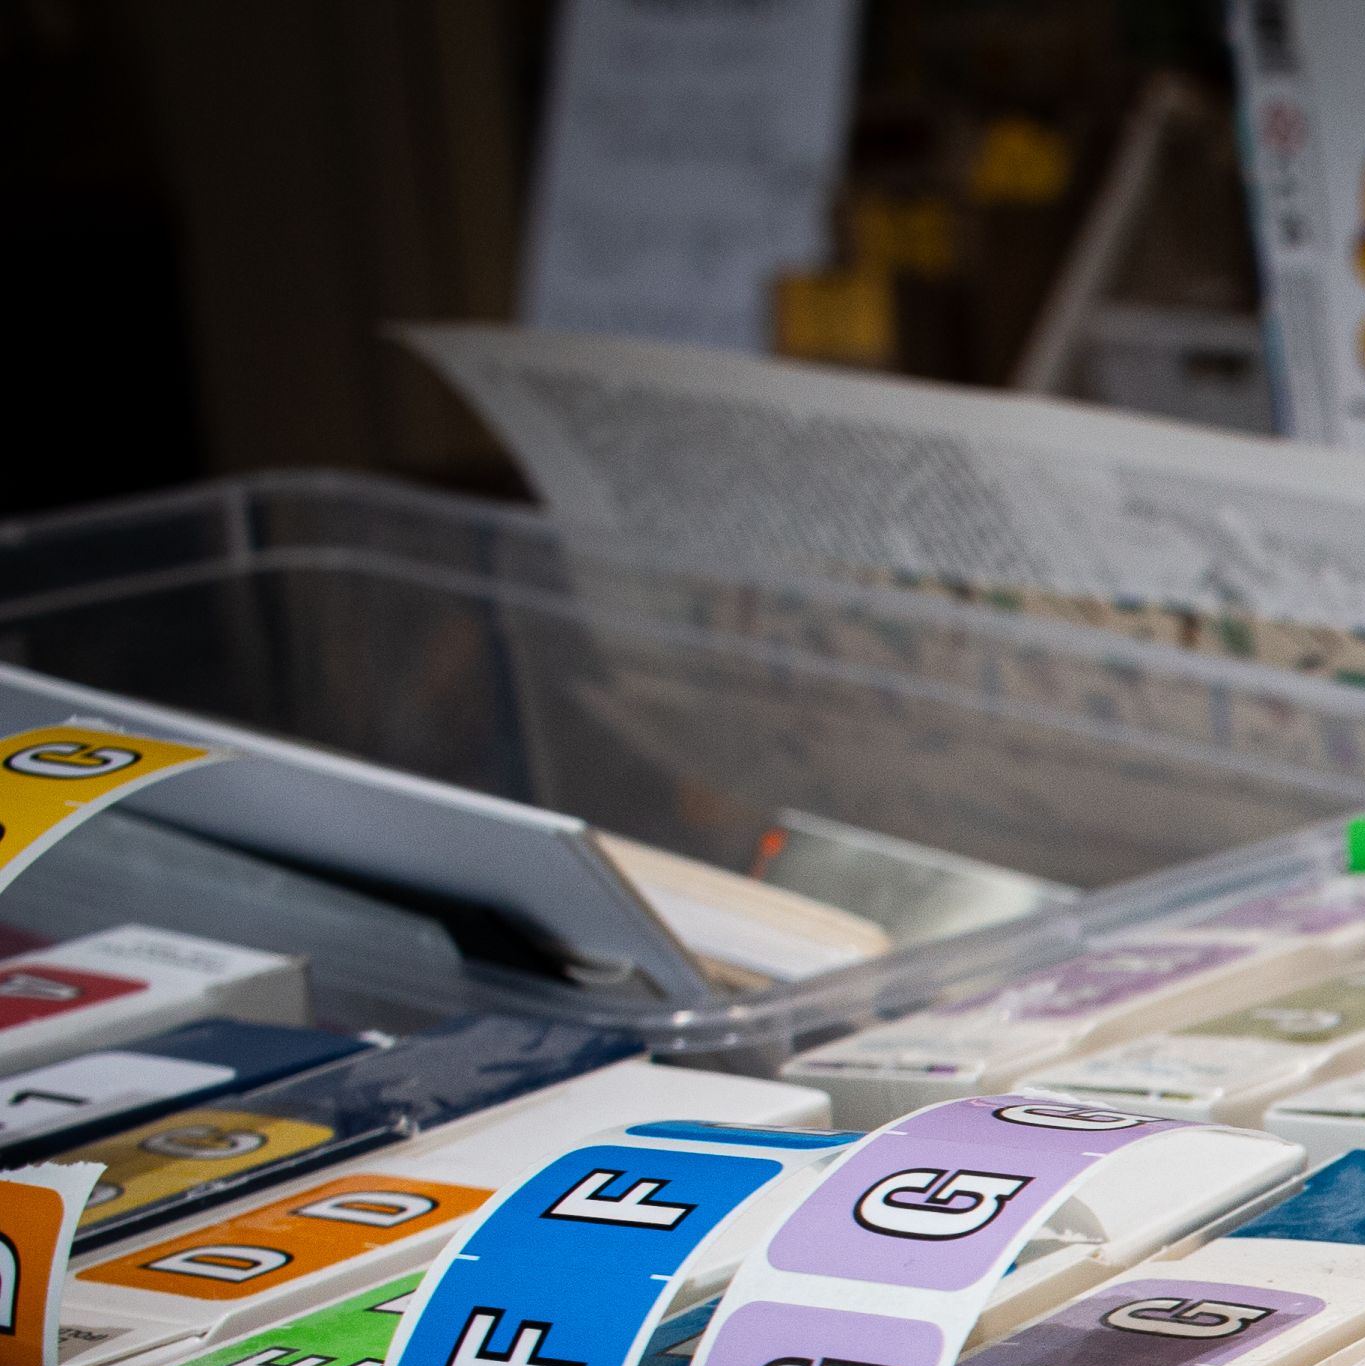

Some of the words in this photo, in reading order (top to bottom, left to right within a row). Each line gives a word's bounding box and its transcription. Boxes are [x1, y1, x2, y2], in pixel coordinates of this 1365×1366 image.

[540, 1167, 700, 1231] F
[852, 1167, 1037, 1242] G
[138, 1243, 295, 1283] D
[287, 1190, 441, 1229] D
[1100, 1297, 1281, 1340] G
